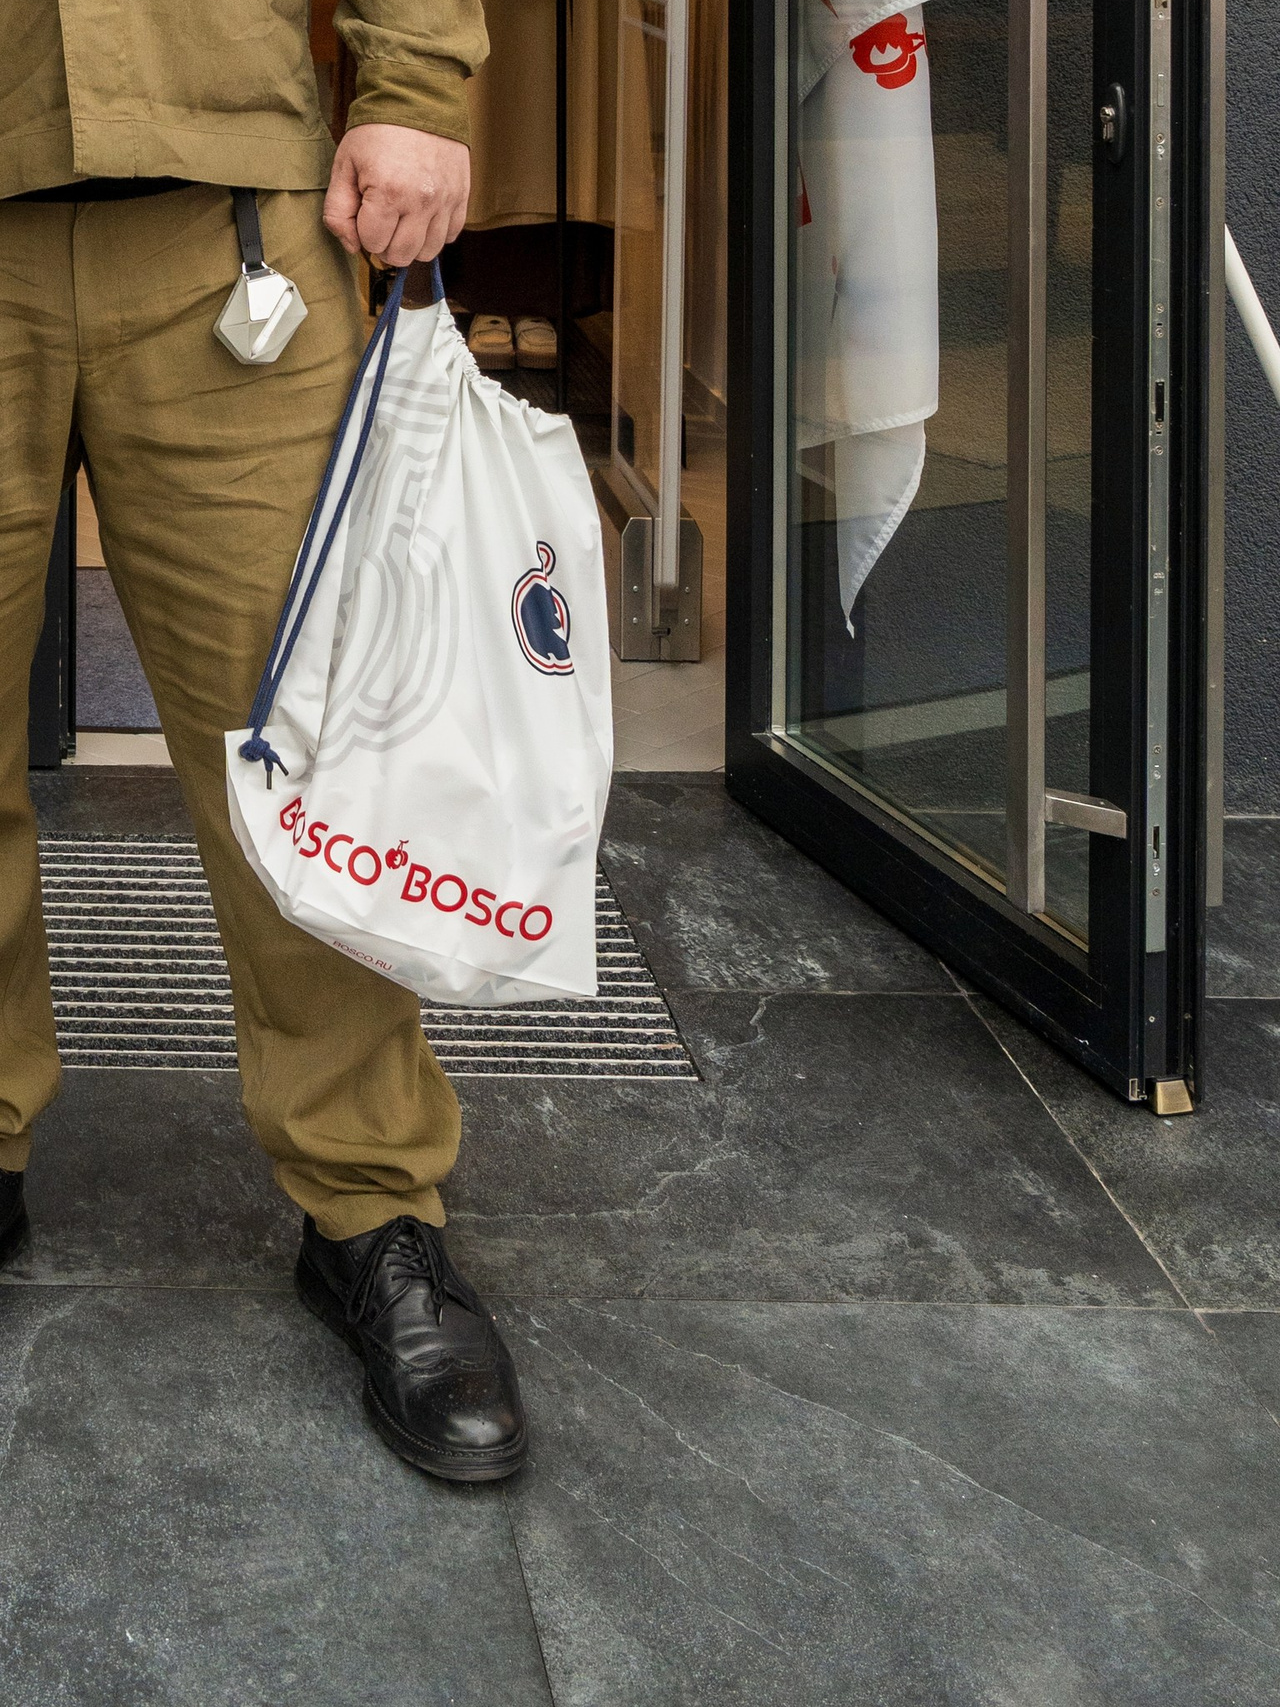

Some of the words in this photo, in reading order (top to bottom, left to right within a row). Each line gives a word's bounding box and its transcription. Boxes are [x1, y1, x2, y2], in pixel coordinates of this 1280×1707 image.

[279, 796, 383, 886] BOSCO
[400, 863, 553, 942] BOSCO
[332, 940, 393, 971] BOSCO.RU
